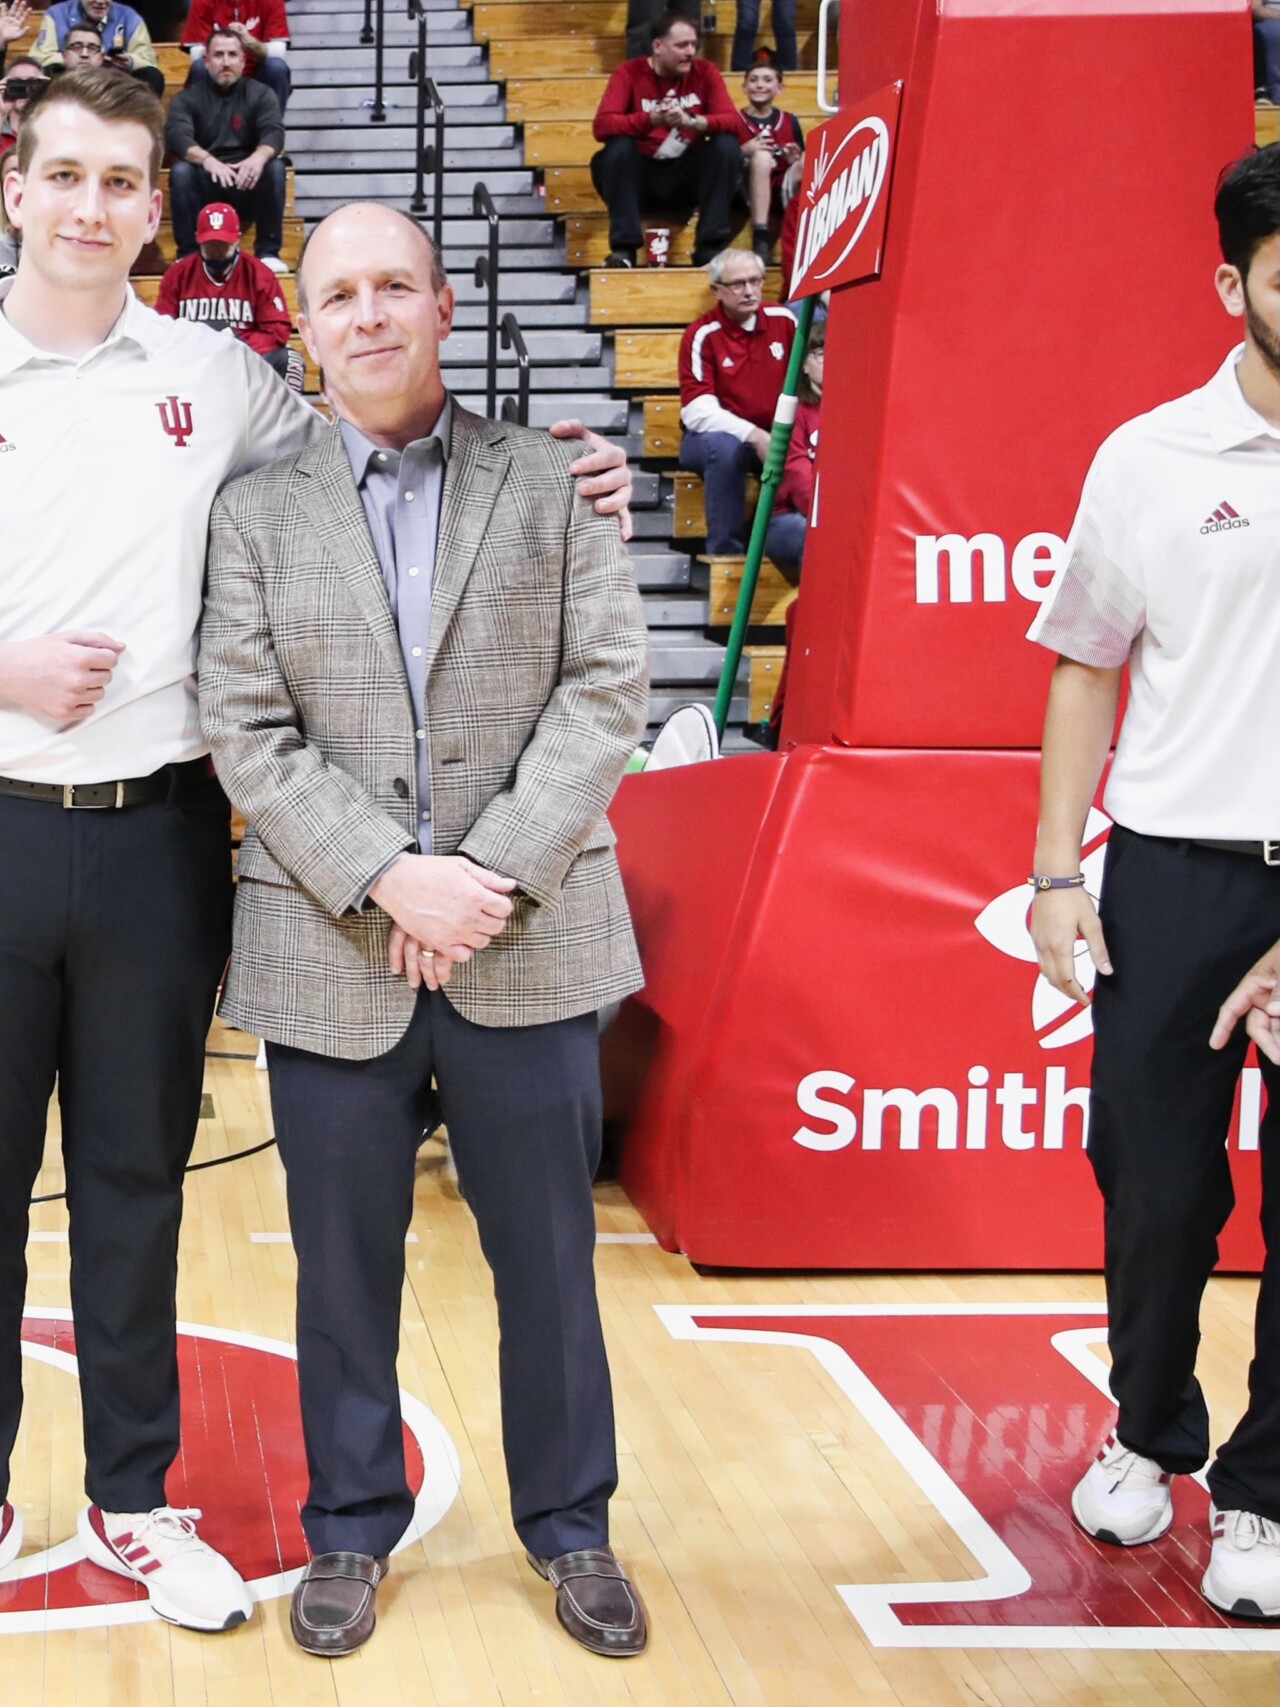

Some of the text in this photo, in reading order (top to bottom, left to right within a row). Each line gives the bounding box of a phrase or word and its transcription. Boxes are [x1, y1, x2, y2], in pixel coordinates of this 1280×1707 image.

[790, 137, 882, 301] LIBMAN
[177, 297, 252, 324] INDIANA
[154, 395, 193, 447] IU
[1199, 516, 1251, 536] adidas
